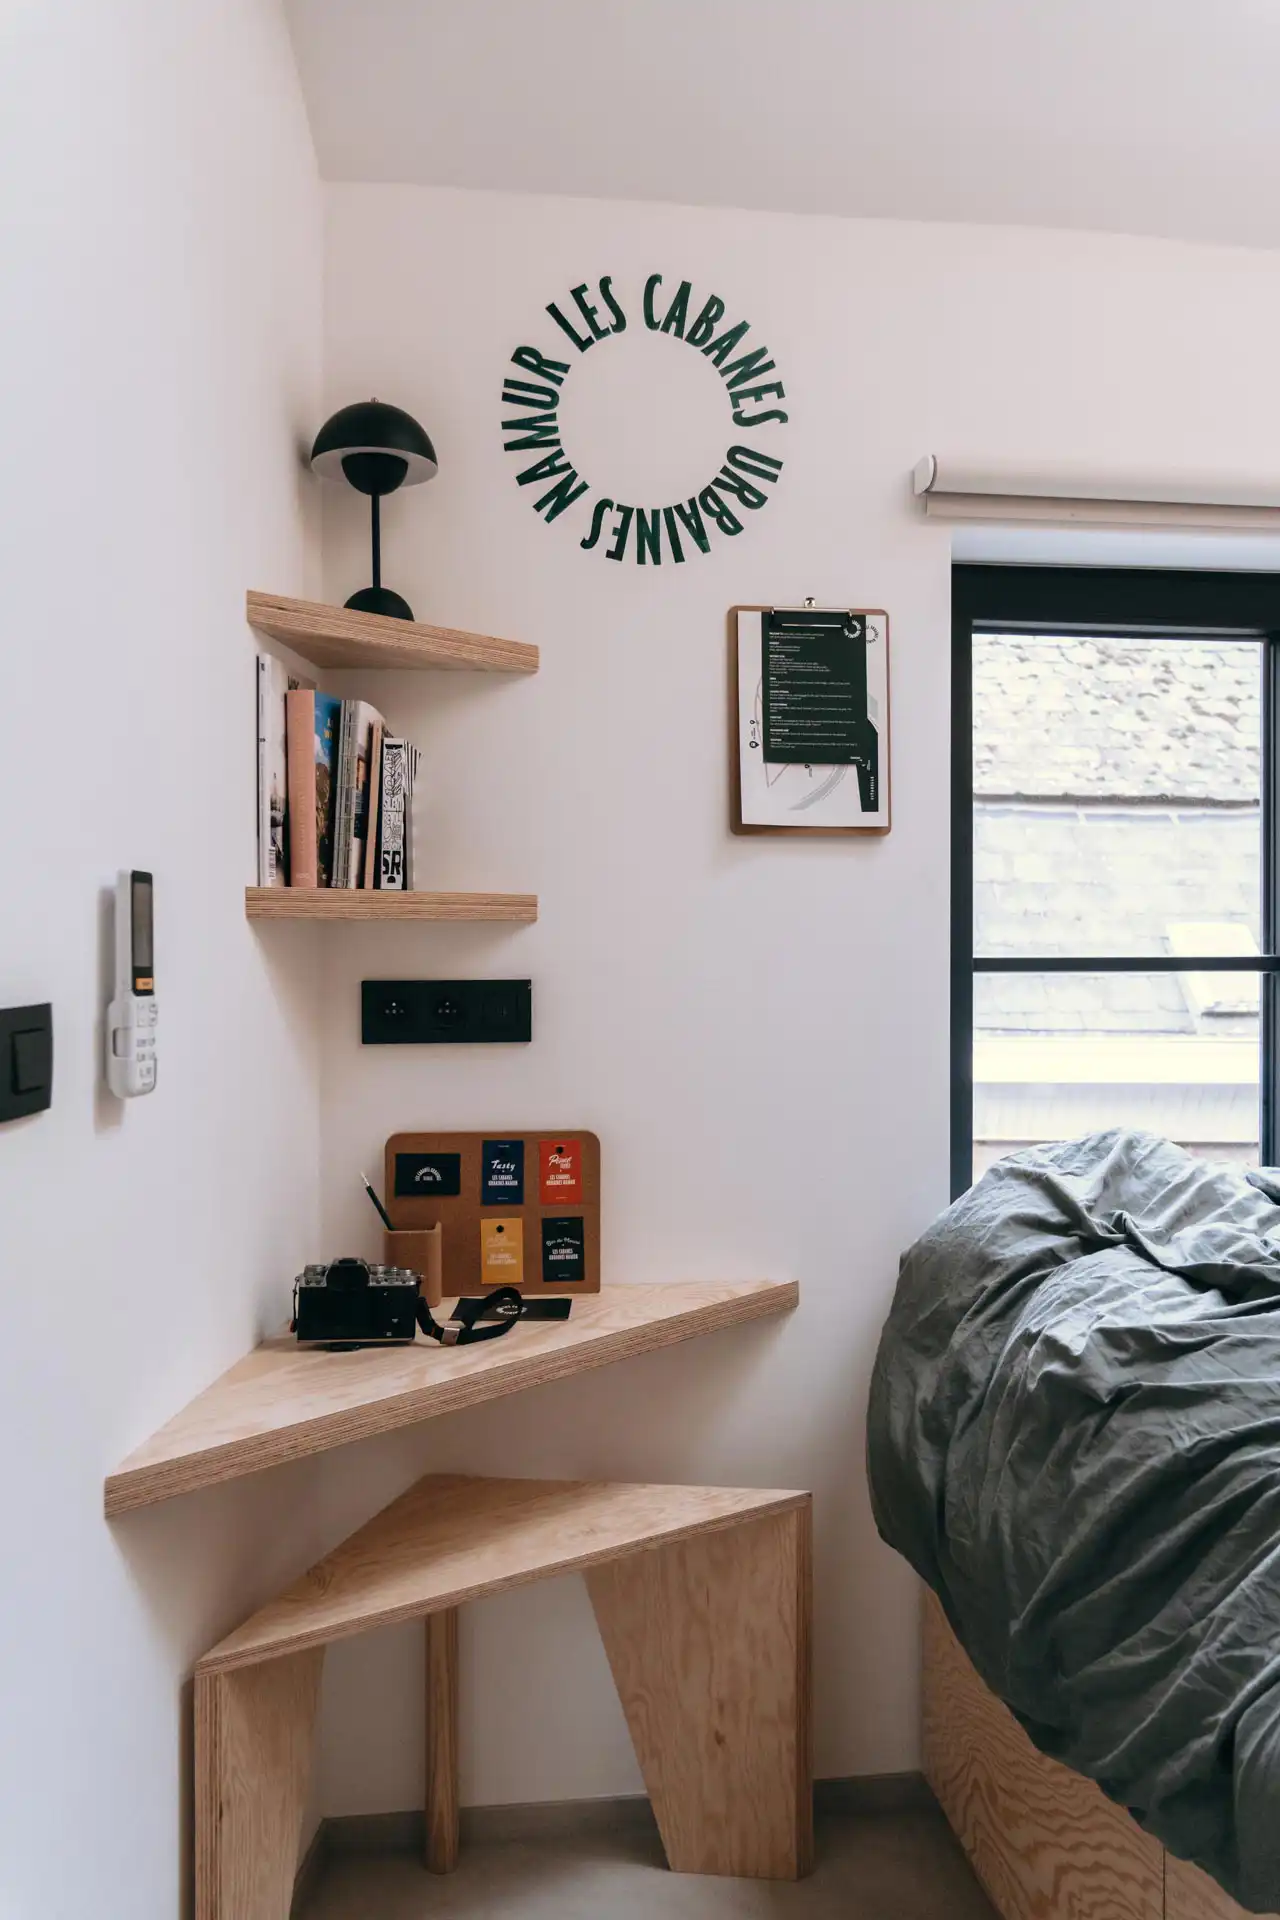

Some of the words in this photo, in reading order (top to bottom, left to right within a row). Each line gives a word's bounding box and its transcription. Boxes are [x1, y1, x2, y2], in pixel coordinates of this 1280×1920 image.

[545, 275, 627, 353] LES
[643, 273, 789, 428] CABANES
[501, 345, 591, 524] NAMUR
[579, 445, 784, 566] URBAINES
[491, 1160, 516, 1171] Tasty
